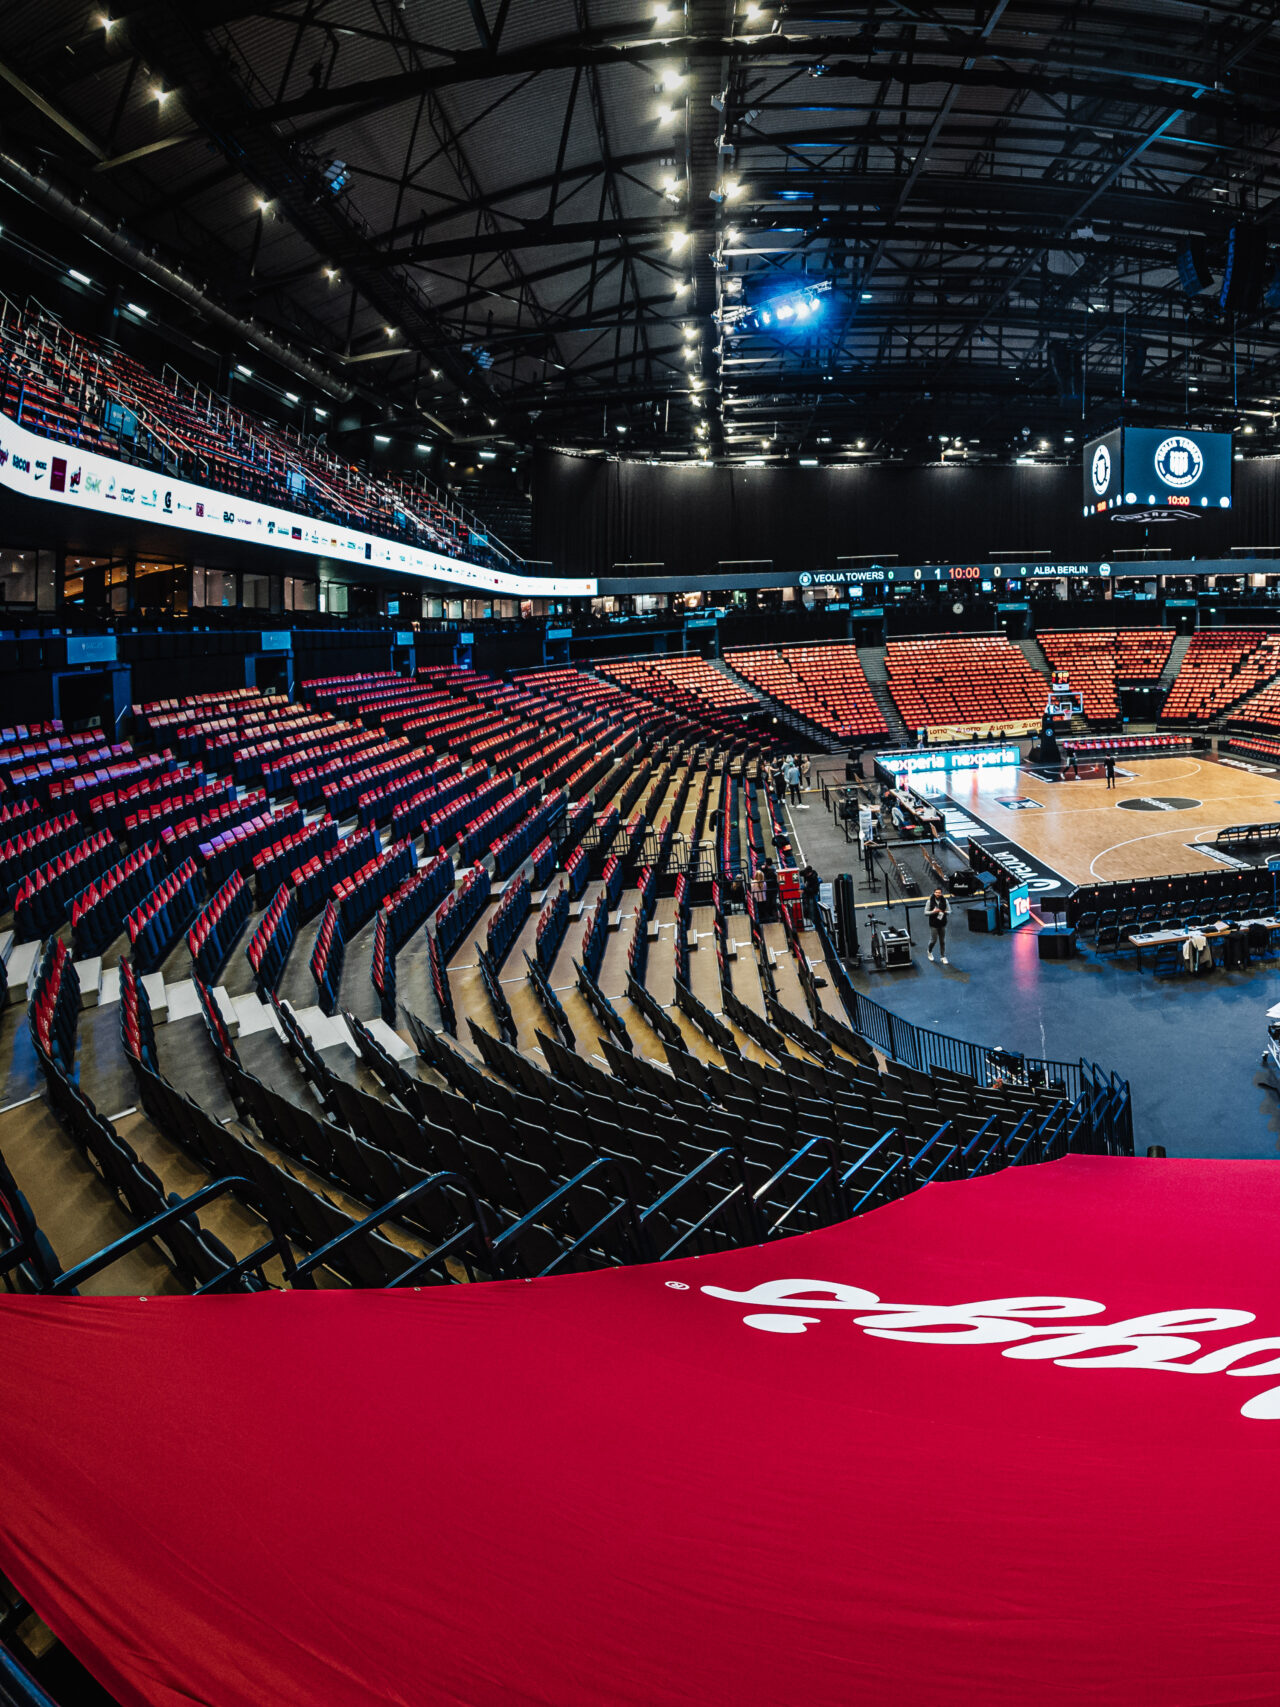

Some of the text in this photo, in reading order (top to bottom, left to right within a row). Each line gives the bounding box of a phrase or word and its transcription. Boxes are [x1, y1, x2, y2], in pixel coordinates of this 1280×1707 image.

[1168, 496, 1190, 506] 10:00
[949, 567, 980, 579] 10:00
[1034, 565, 1088, 576] ALBA BERLIN
[814, 571, 884, 583] VEOLIA TOWERS
[951, 749, 1015, 769] nexperia
